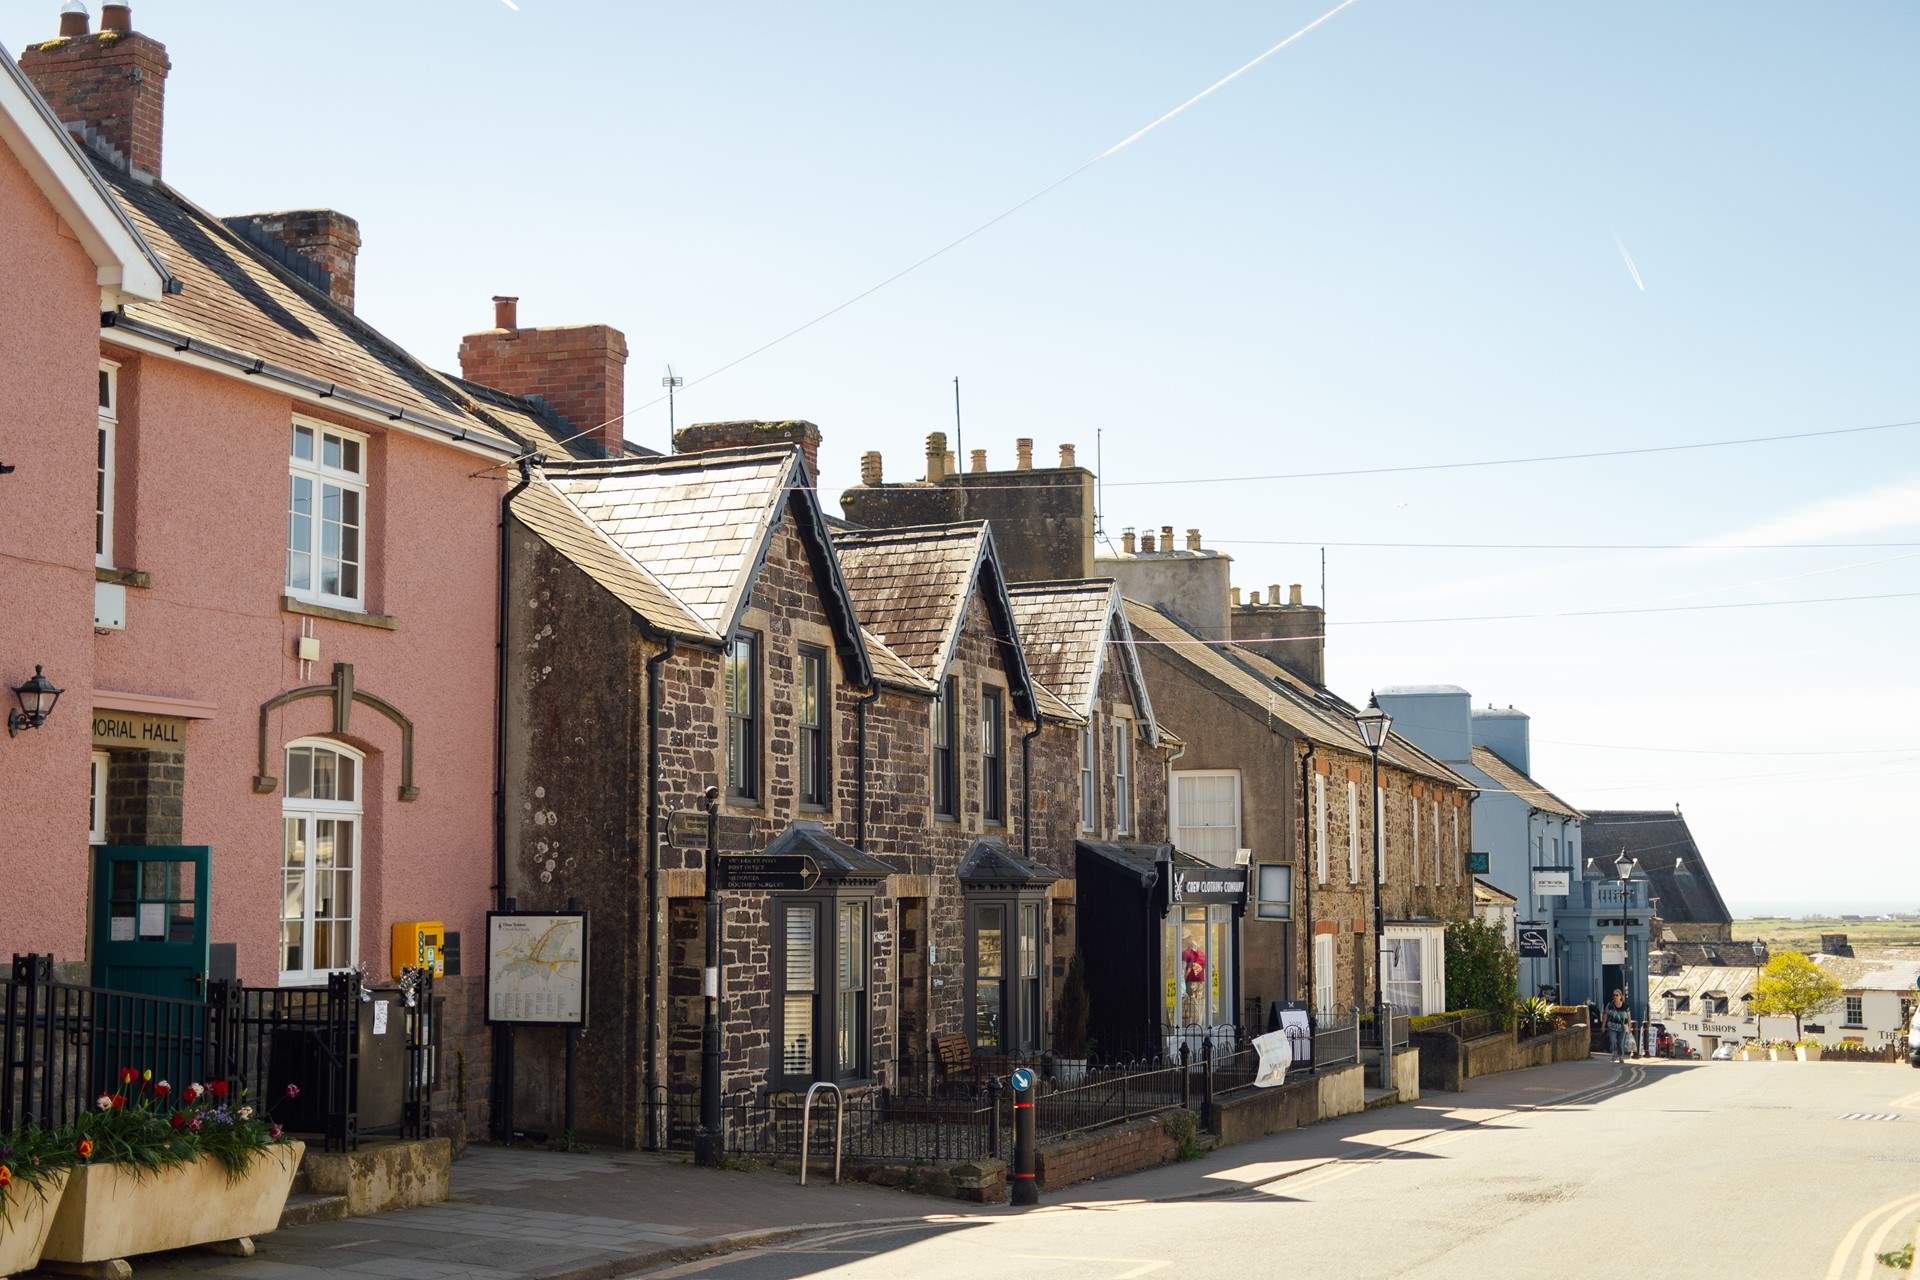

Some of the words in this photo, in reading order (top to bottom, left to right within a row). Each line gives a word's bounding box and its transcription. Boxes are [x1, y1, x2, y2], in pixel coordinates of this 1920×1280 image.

[142, 723, 178, 742] HALL
[1186, 881, 1200, 893] CREW
[1200, 881, 1224, 893] CLOTHING
[1682, 1022, 1699, 1031] THE
[1702, 1023, 1737, 1033] BISHOPS
[1878, 1030, 1898, 1040] THE
